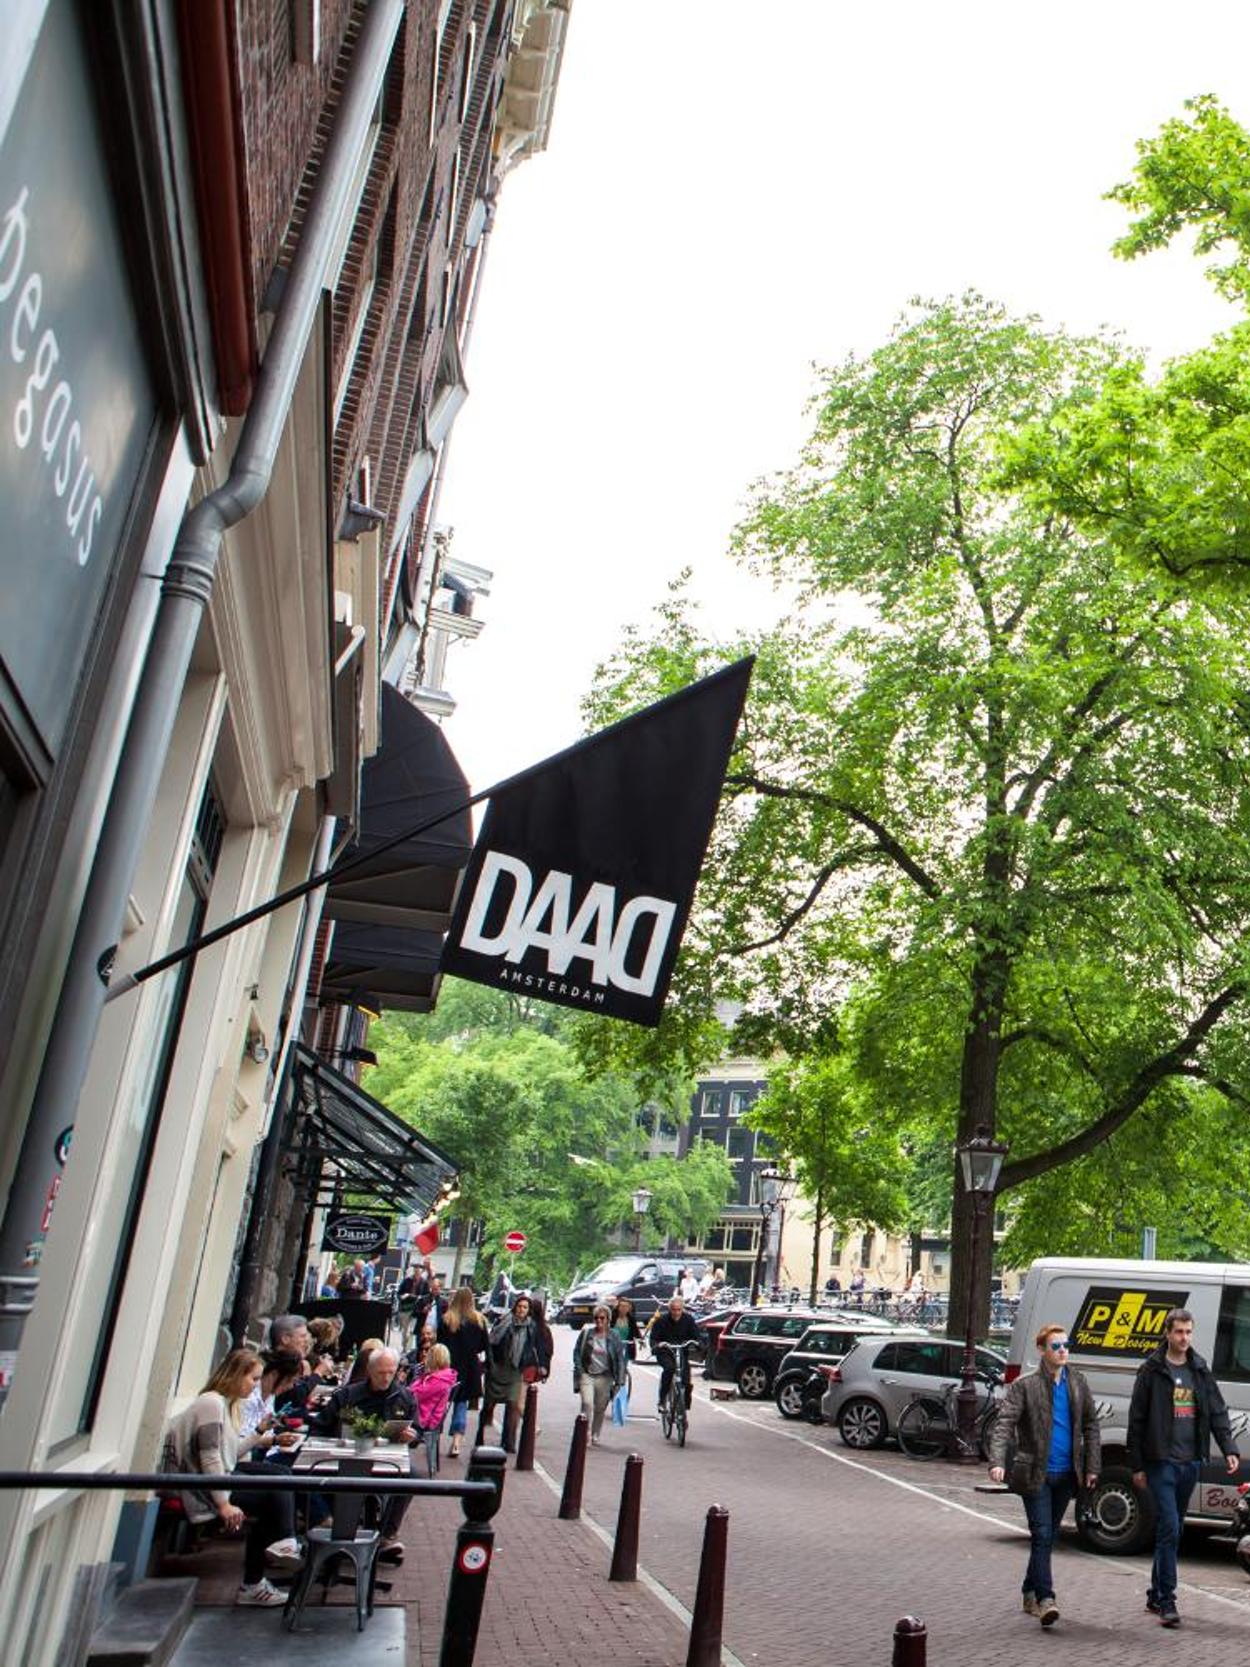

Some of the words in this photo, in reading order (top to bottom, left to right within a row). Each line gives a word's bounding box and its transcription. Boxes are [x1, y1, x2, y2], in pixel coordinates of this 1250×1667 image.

[499, 968, 605, 1004] AMSTERDAM
[335, 1227, 379, 1240] Dante
[1076, 1332, 1104, 1346] New
[1112, 1333, 1160, 1353] Design
